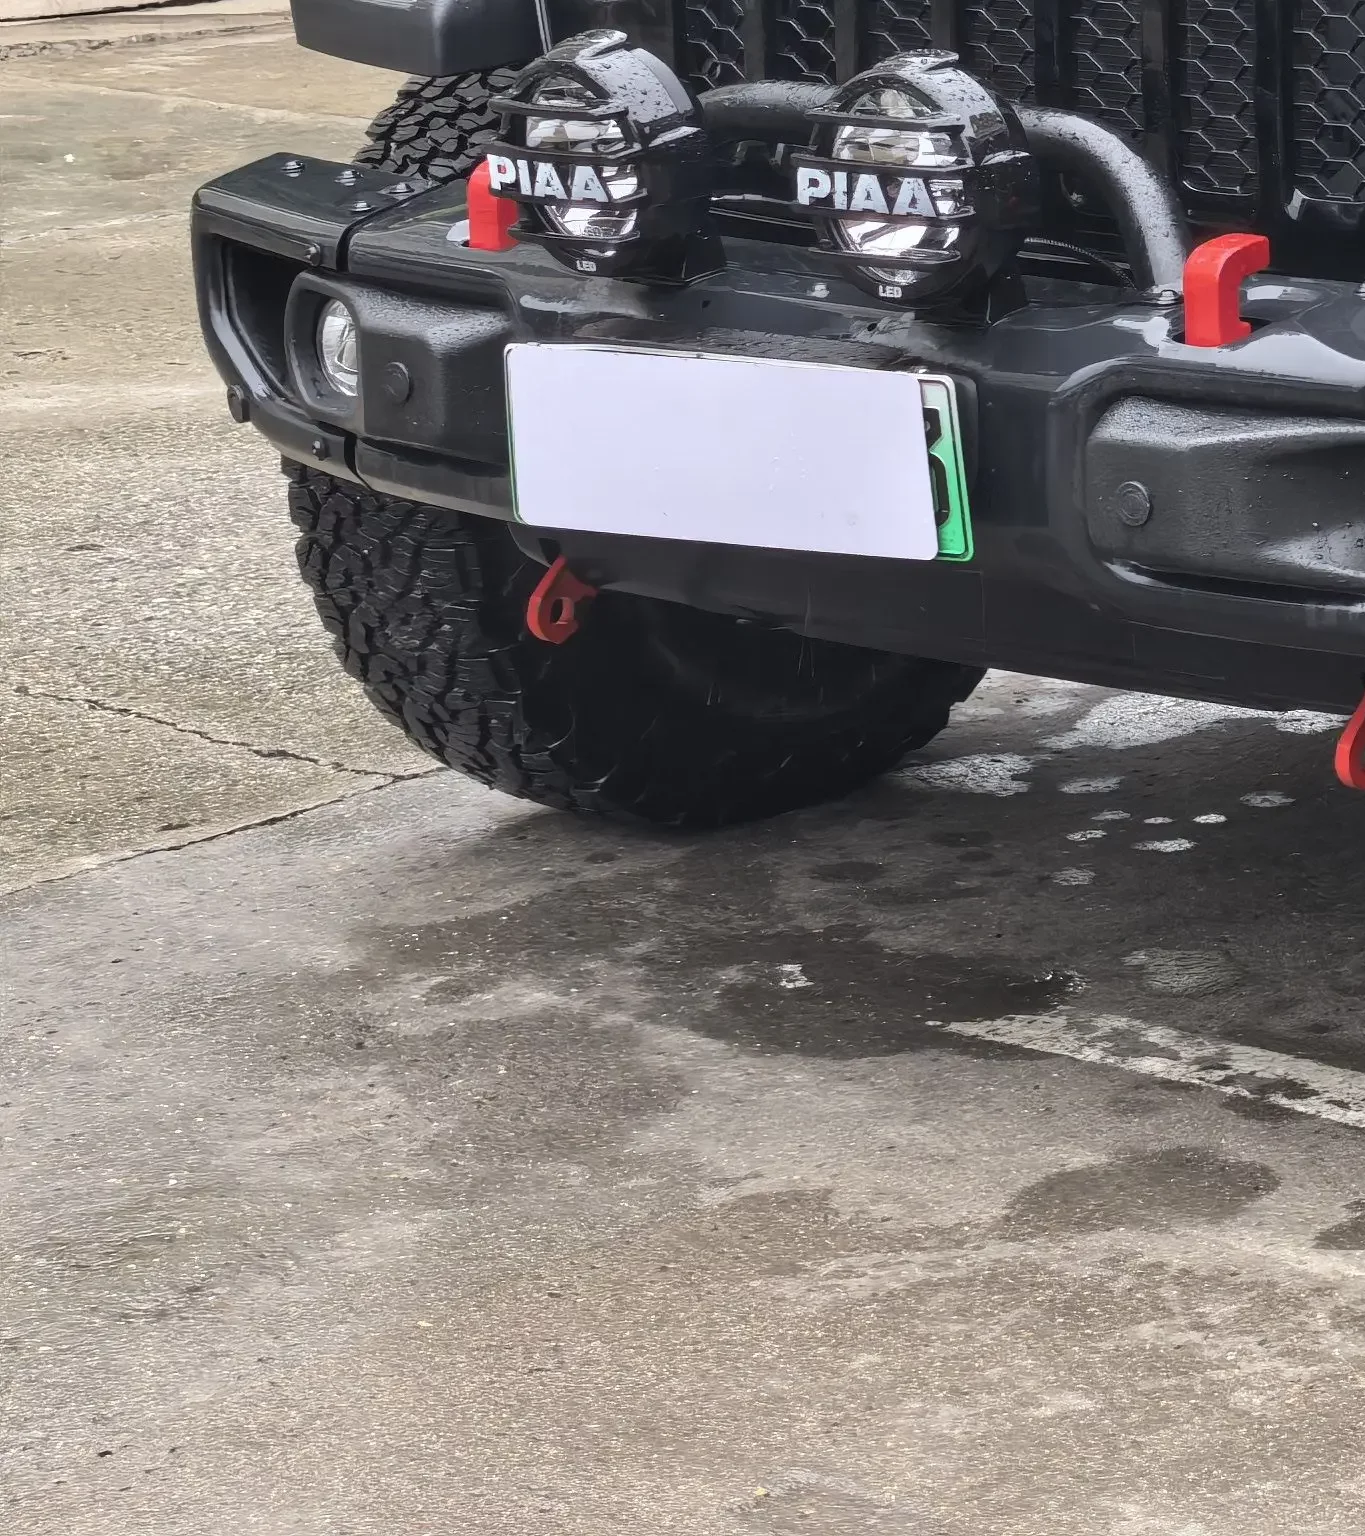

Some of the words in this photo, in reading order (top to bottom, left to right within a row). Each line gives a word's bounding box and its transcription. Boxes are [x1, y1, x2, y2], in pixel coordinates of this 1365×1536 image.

[486, 153, 609, 203] PIAA
[796, 166, 937, 218] PIAA
[576, 259, 597, 272] LED
[878, 284, 903, 298] LED
